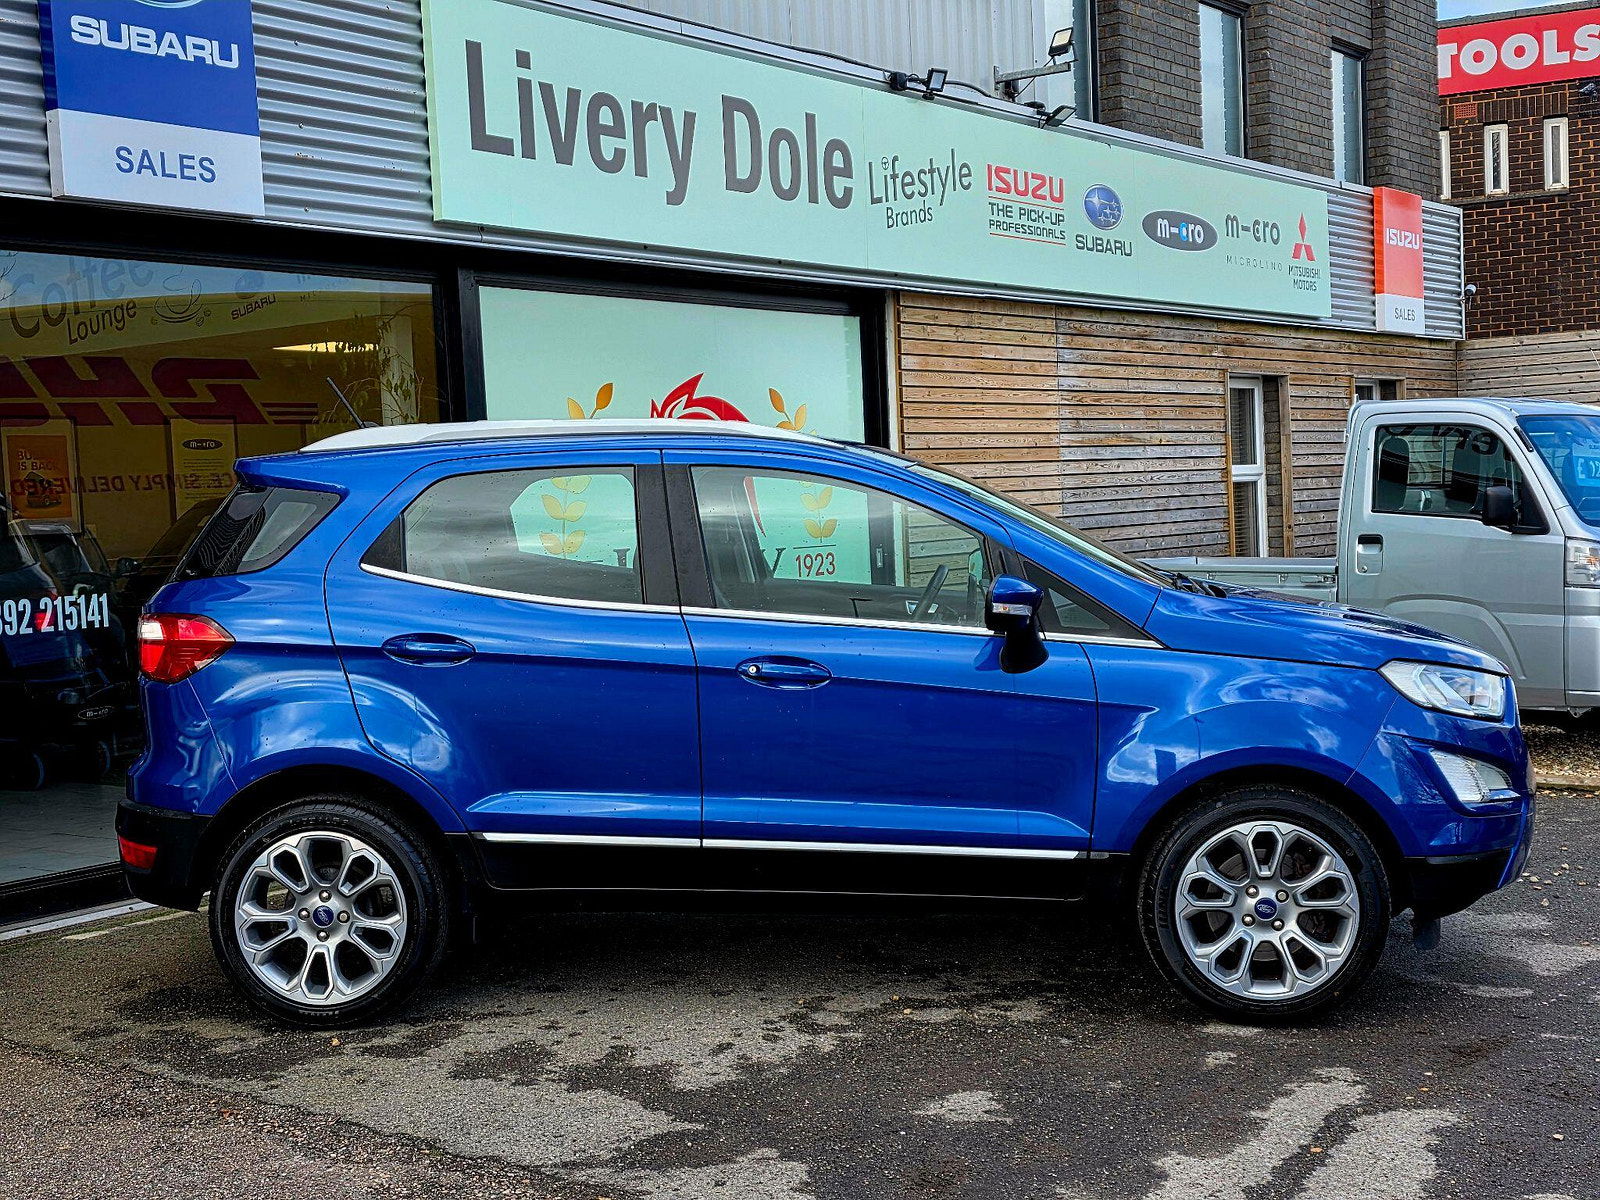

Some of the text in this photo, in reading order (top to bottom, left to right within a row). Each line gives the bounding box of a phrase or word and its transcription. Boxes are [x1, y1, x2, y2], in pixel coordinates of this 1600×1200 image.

[70, 15, 240, 69] SUBARU
[1437, 24, 1600, 78] TOOLS
[465, 39, 854, 209] Livery Dole
[115, 146, 217, 184] SALES
[868, 148, 973, 206] Lifestyle
[986, 163, 1065, 204] ISUZU
[886, 200, 934, 229] Brands
[988, 202, 1065, 226] THE PICK-UP
[989, 219, 1066, 240] PROFESSIONALS
[1385, 227, 1420, 250] ISUZU
[1075, 233, 1133, 257] SUBARU
[1226, 254, 1283, 272] MICROLINO
[1288, 264, 1321, 280] MITSUBISHI
[1293, 278, 1317, 292] MOTORS
[231, 294, 277, 320] SUBARU
[1394, 307, 1416, 321] SALES
[66, 298, 137, 345] Lounge
[795, 551, 837, 577] 1923
[39, 592, 110, 633] 215141
